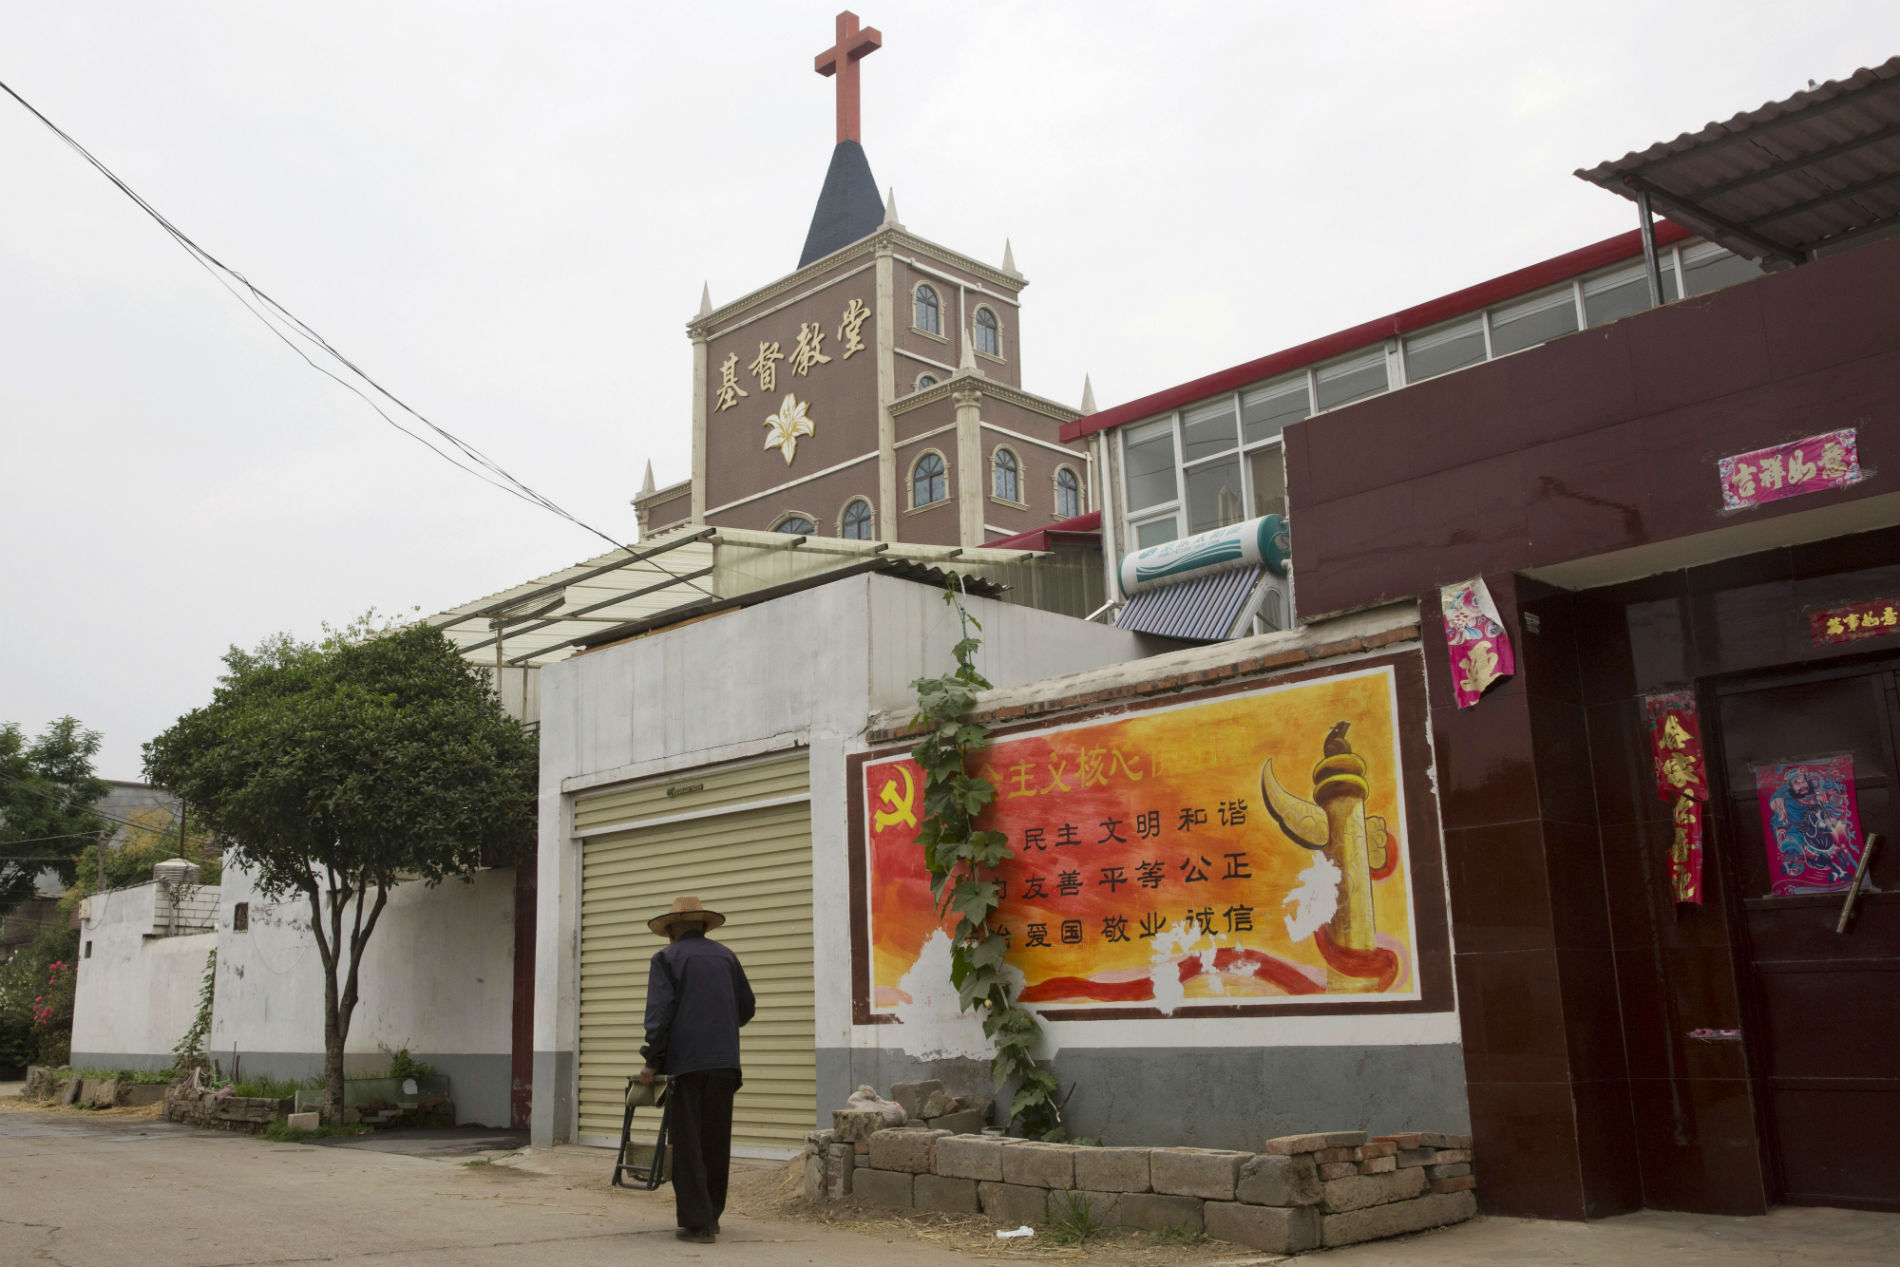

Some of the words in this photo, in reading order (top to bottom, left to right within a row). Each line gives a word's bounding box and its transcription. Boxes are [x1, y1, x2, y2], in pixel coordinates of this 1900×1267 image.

[714, 298, 873, 413] 基督教堂
[1731, 442, 1848, 497] 吉祥如意
[1024, 823, 1082, 851] 民主
[1098, 810, 1161, 844] 文明
[1177, 798, 1248, 832] 和谐
[1021, 869, 1083, 899] 友善
[1098, 859, 1166, 893] 平等
[1180, 852, 1252, 884] 公正
[1025, 920, 1083, 947] 爱国
[1101, 911, 1167, 943] 敬业
[1186, 904, 1254, 936] 诚信
